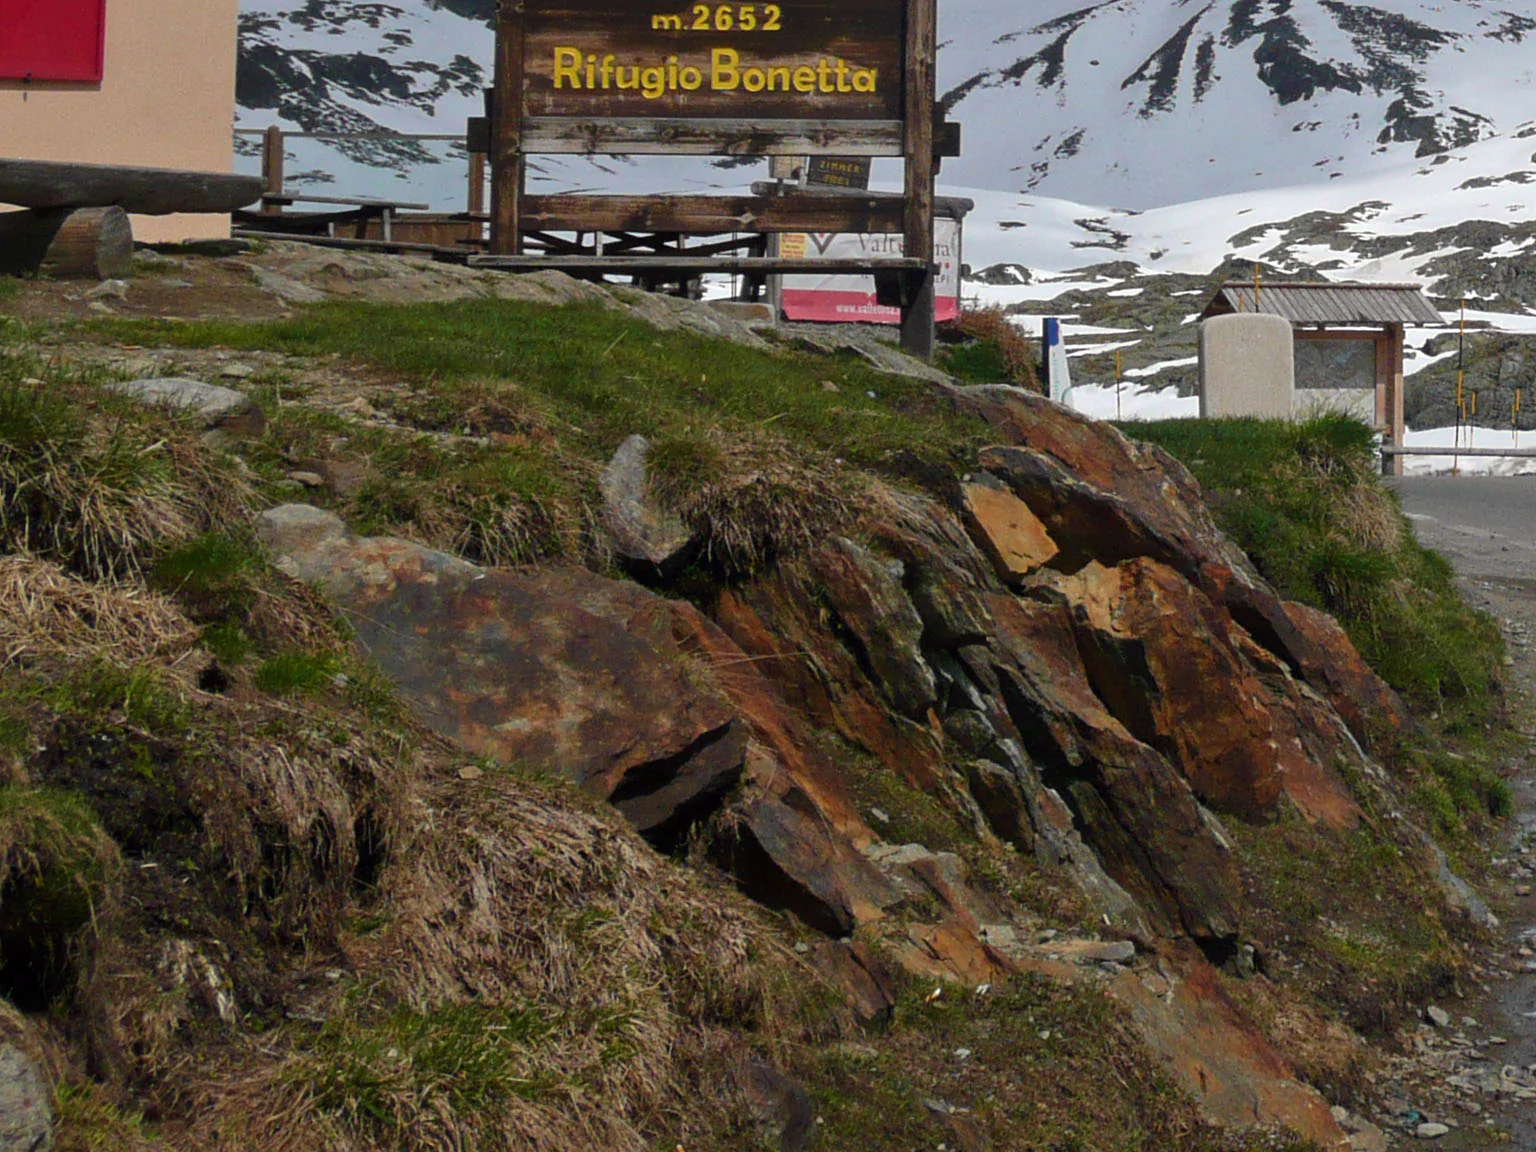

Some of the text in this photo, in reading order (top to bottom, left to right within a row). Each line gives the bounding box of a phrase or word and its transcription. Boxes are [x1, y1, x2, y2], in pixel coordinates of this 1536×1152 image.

[651, 4, 782, 31] m.2652
[553, 46, 877, 99] Rifugio Bonetta
